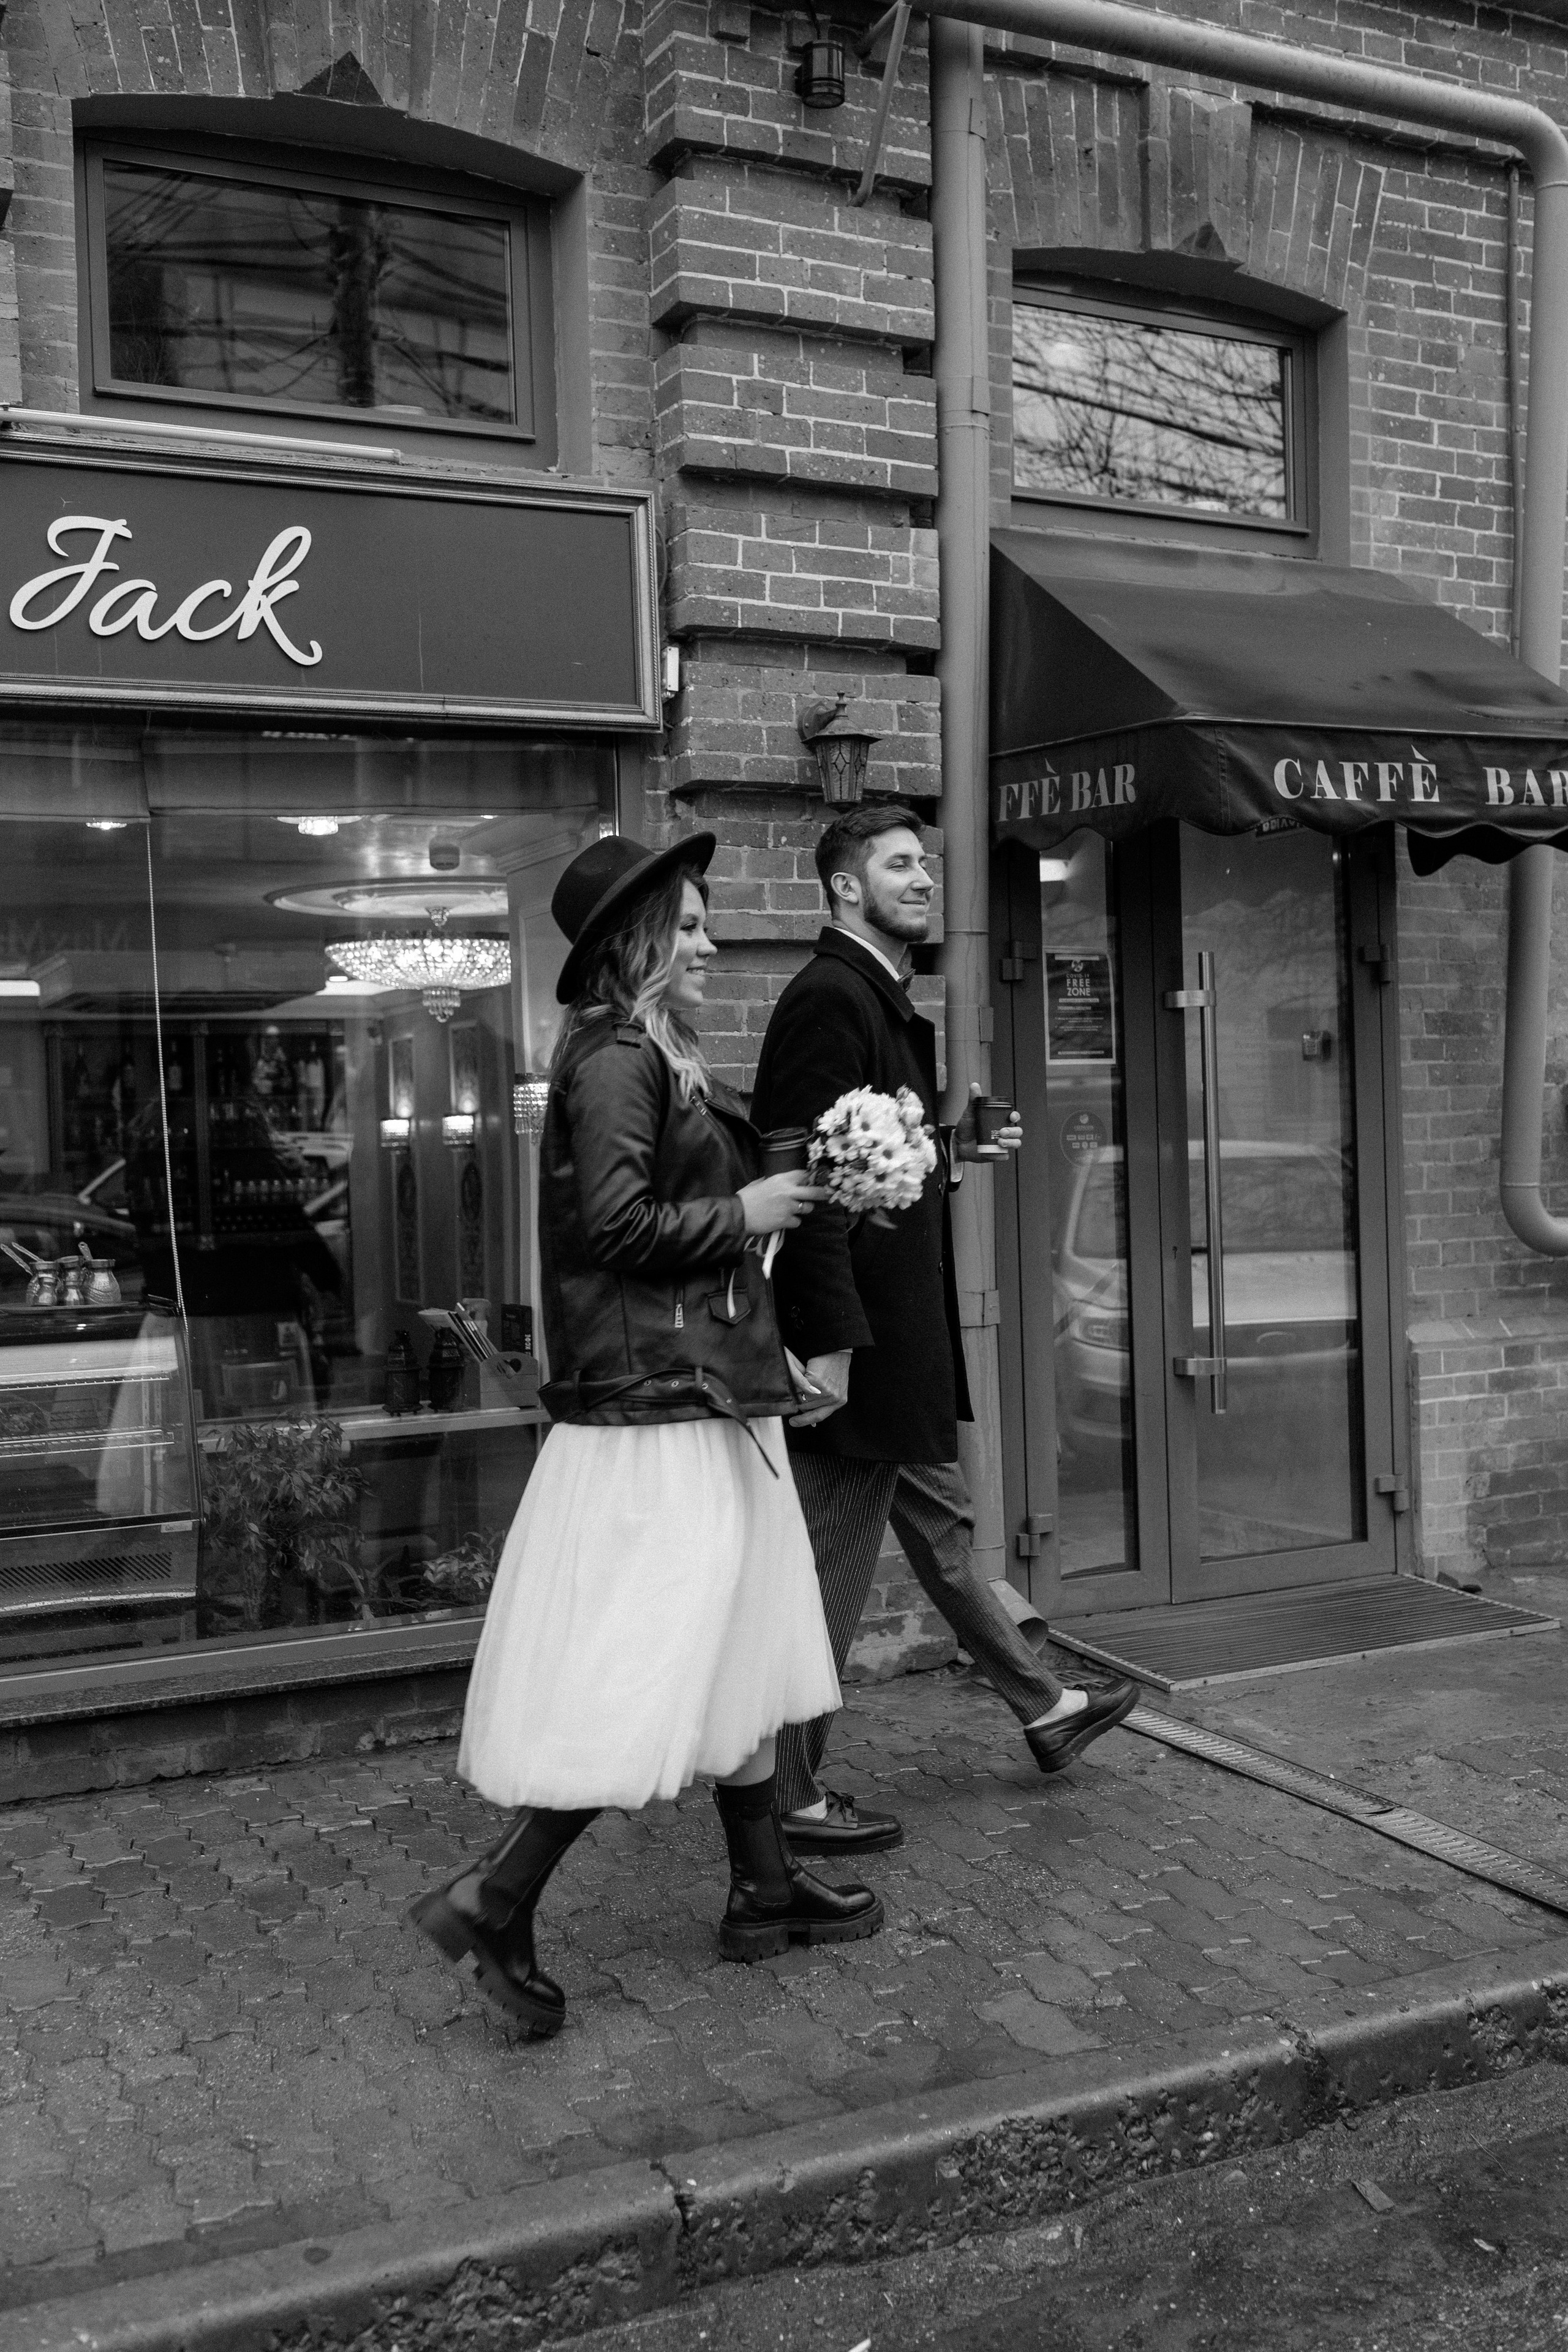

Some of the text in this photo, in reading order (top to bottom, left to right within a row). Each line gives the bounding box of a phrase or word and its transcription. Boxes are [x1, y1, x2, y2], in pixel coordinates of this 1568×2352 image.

[9, 515, 323, 666] Jack
[1069, 763, 1136, 812] BAR
[1273, 745, 1568, 807] CAFFÈ BAR
[1066, 978, 1090, 987] FREE
[1066, 987, 1091, 997] ZONE
